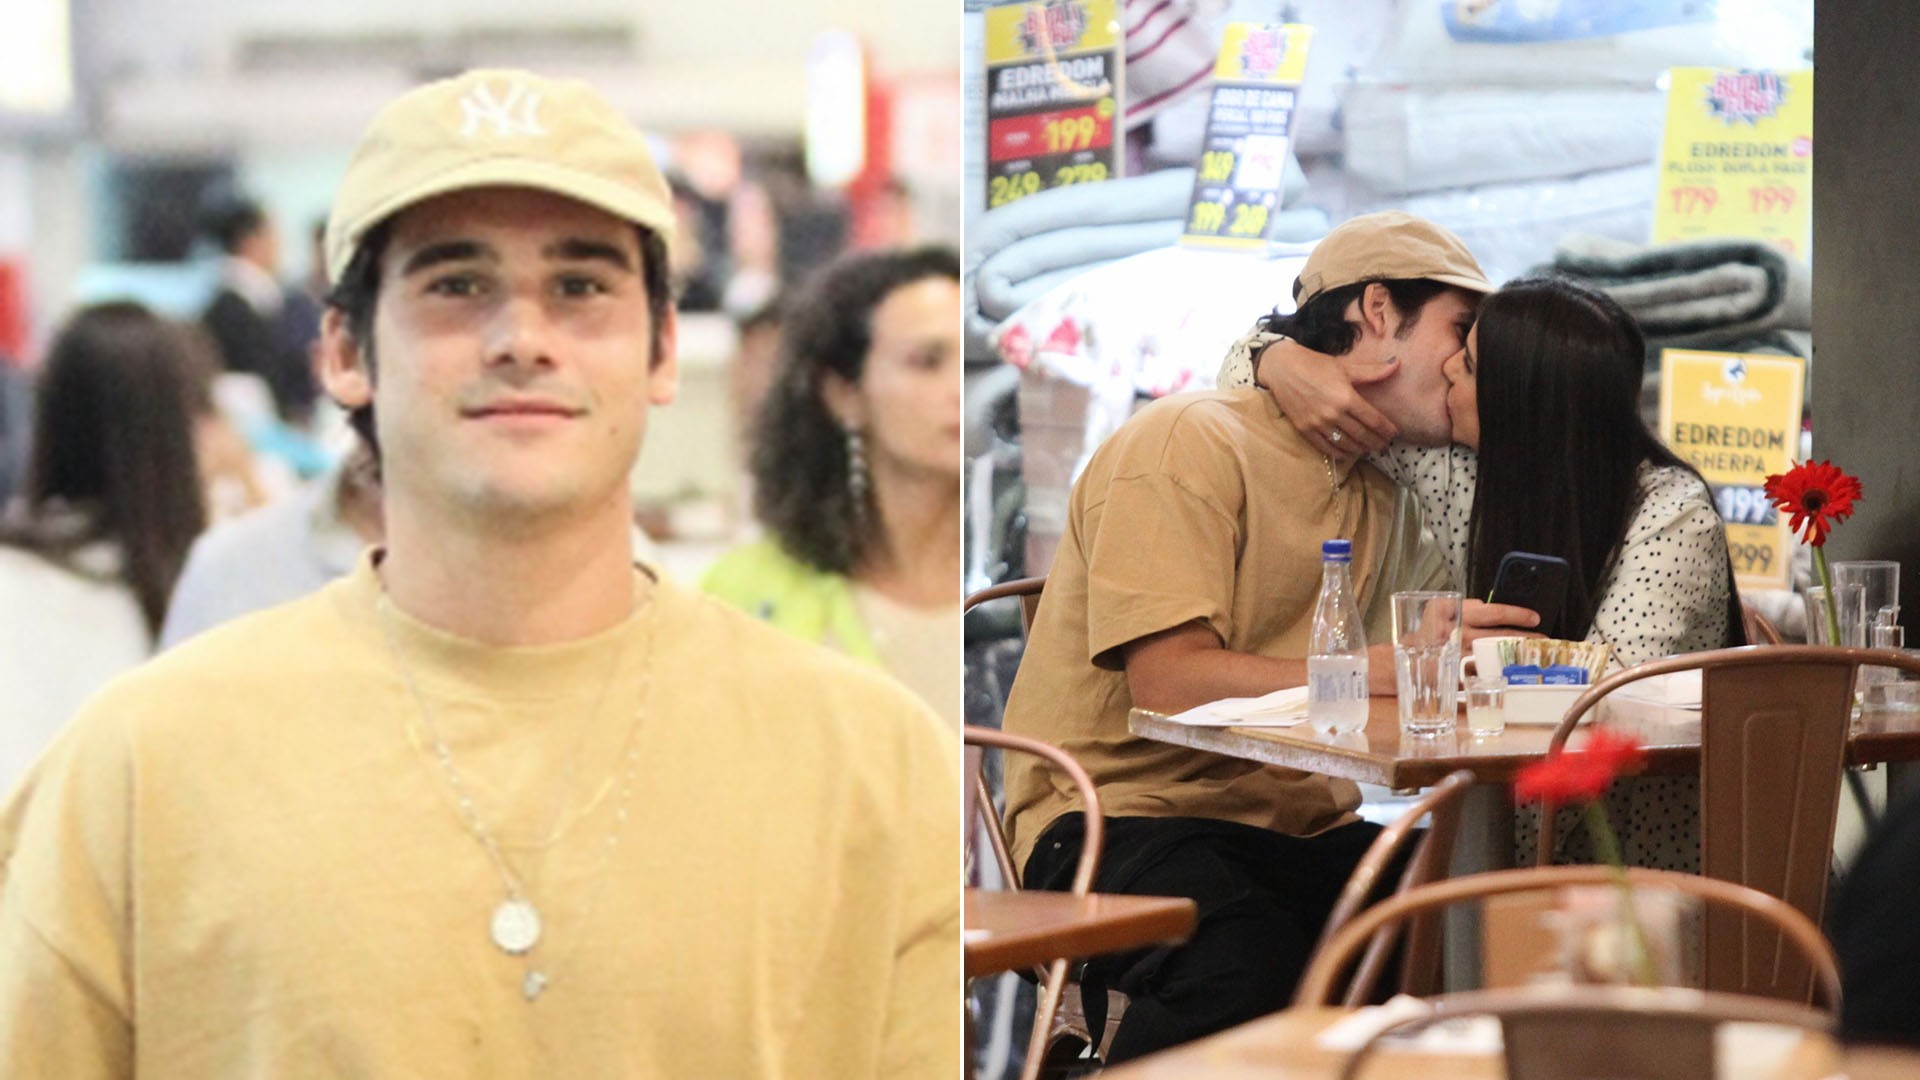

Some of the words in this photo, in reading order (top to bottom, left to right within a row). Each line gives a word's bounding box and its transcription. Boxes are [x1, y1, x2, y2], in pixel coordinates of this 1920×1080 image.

[1000, 55, 1104, 90] EDREDOM
[459, 77, 547, 136] NY
[1047, 116, 1096, 152] 199
[1670, 186, 1719, 215] 179
[1748, 186, 1797, 215] 199
[1674, 422, 1784, 450] EDREDOM
[1721, 486, 1769, 522] 199
